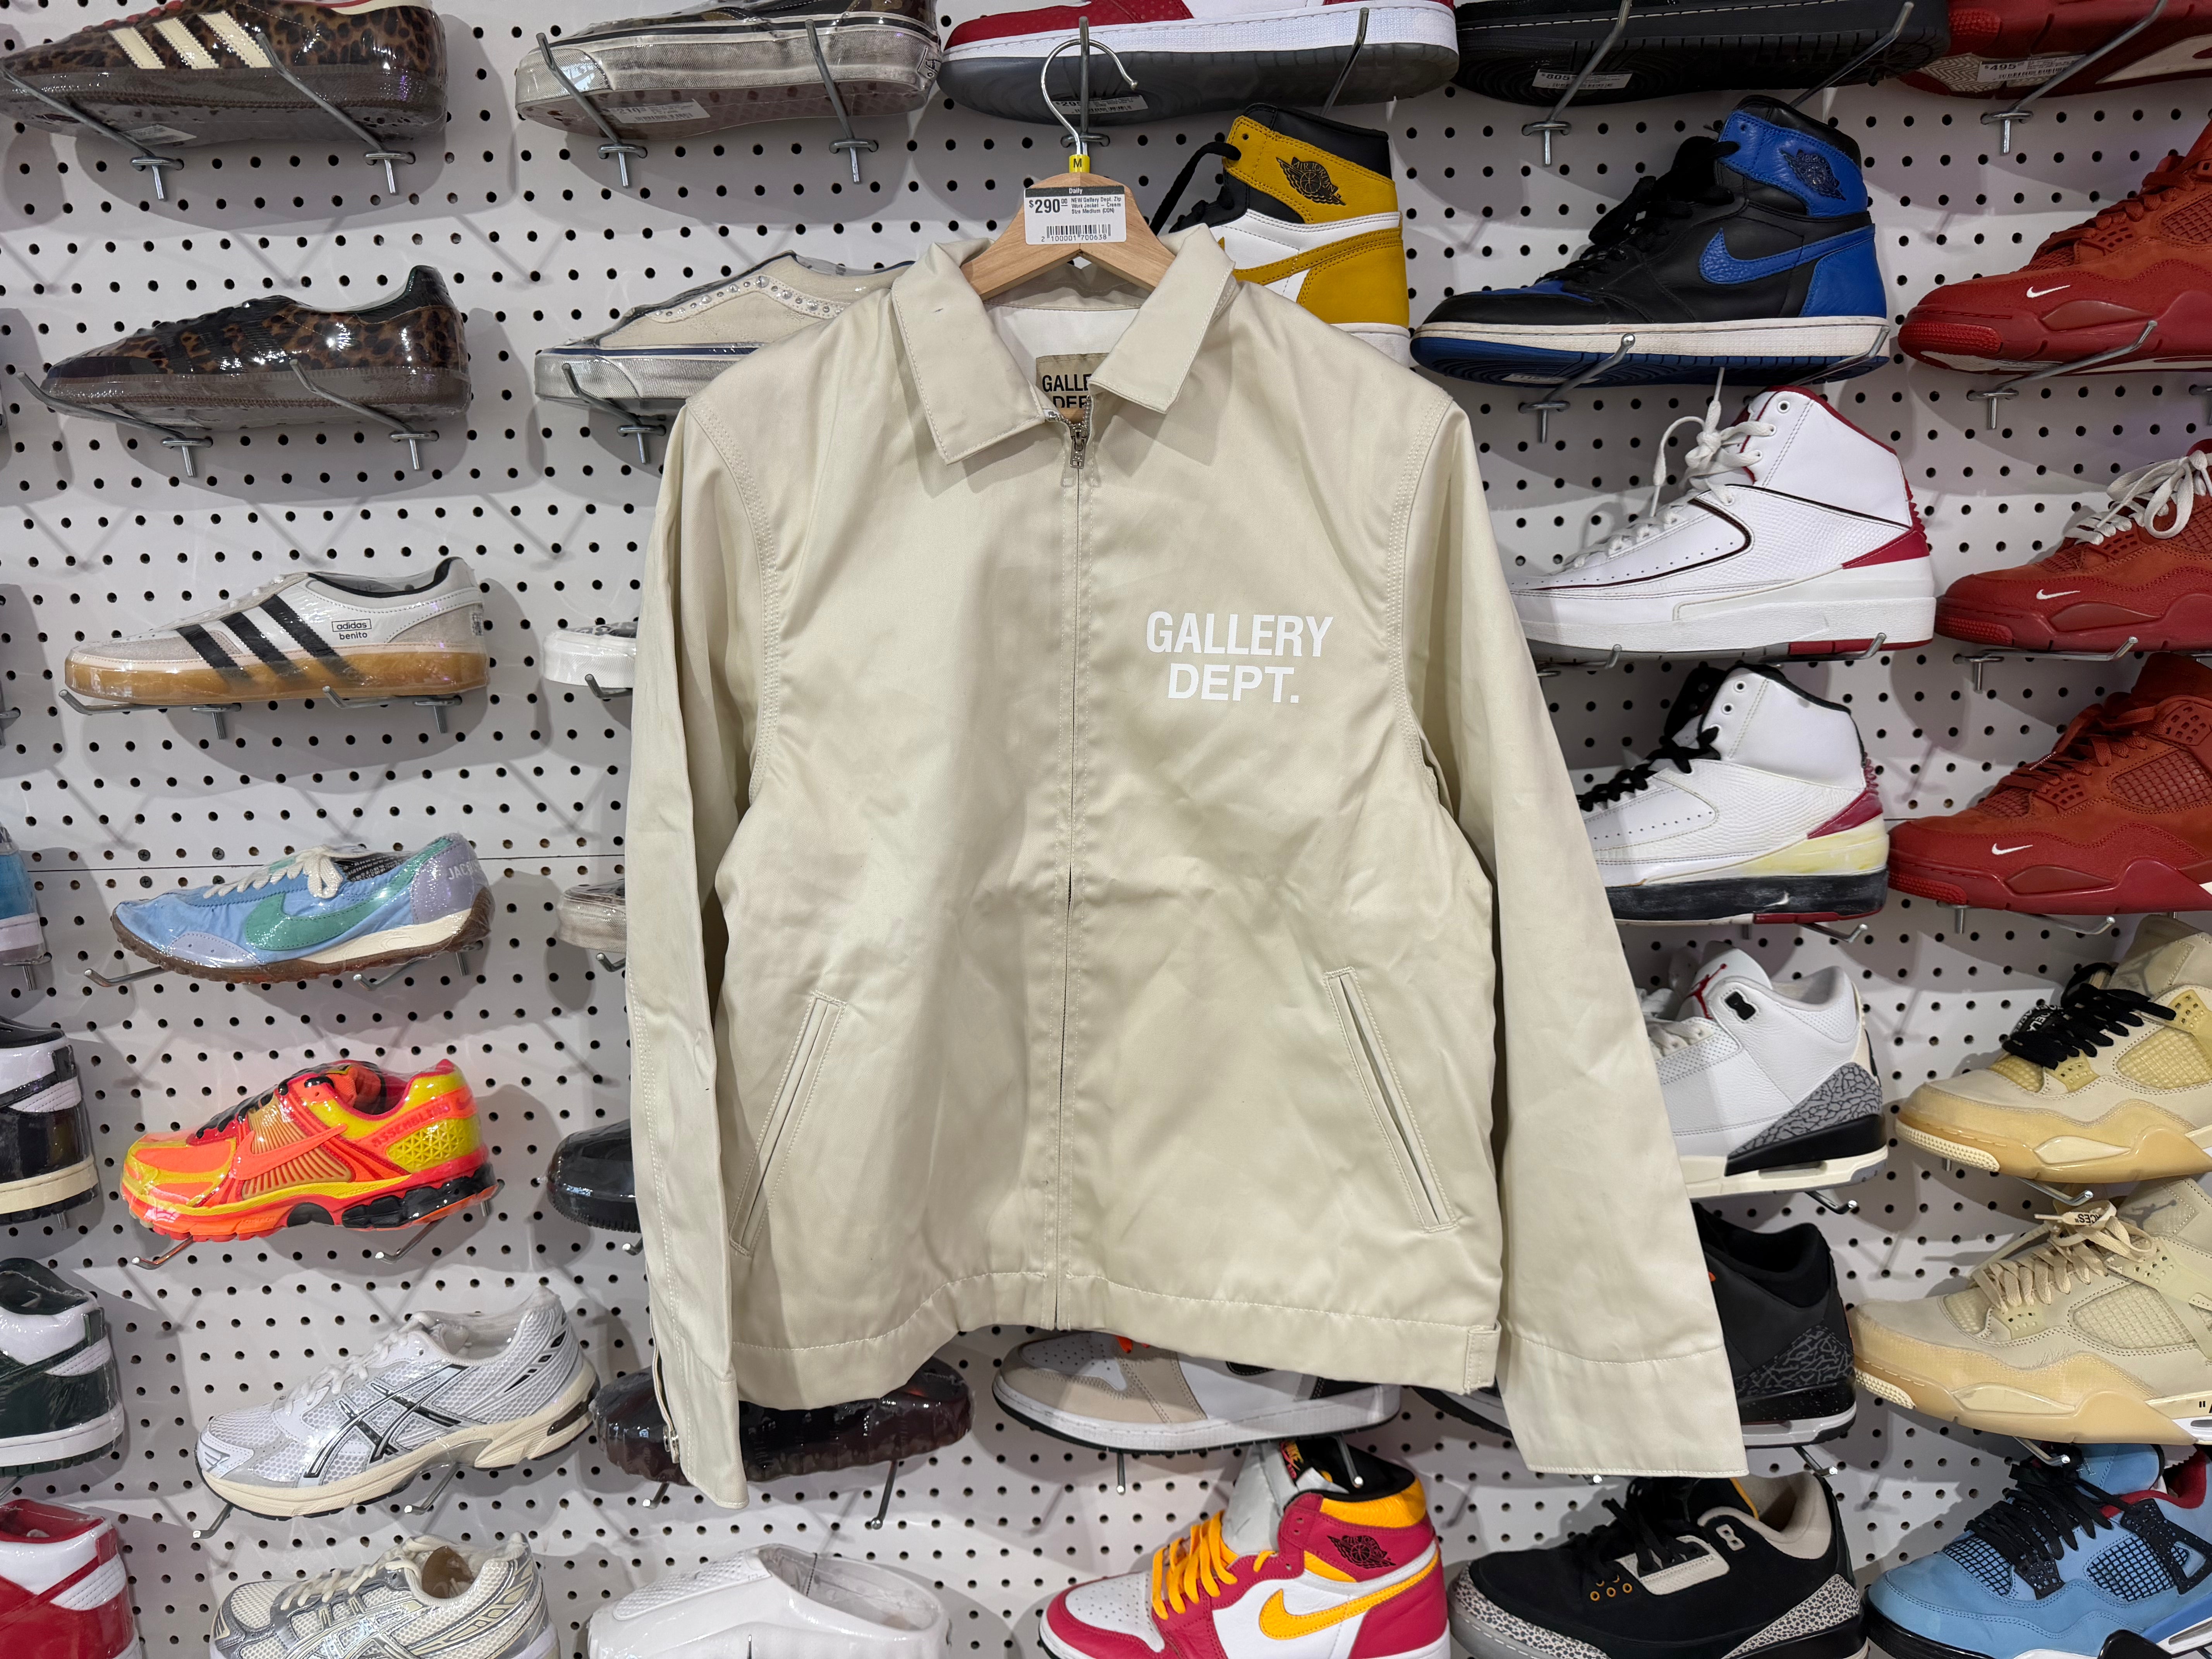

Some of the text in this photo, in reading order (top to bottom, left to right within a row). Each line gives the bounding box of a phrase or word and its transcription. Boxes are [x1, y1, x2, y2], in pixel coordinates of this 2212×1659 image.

[1073, 158, 1082, 168] M
[1293, 161, 1309, 170] AIR
[1029, 199, 1060, 213] $290
[337, 621, 367, 630] adidas
[339, 631, 368, 640] benito
[1147, 611, 1333, 657] GALLERY
[1168, 663, 1299, 704] DEPT.
